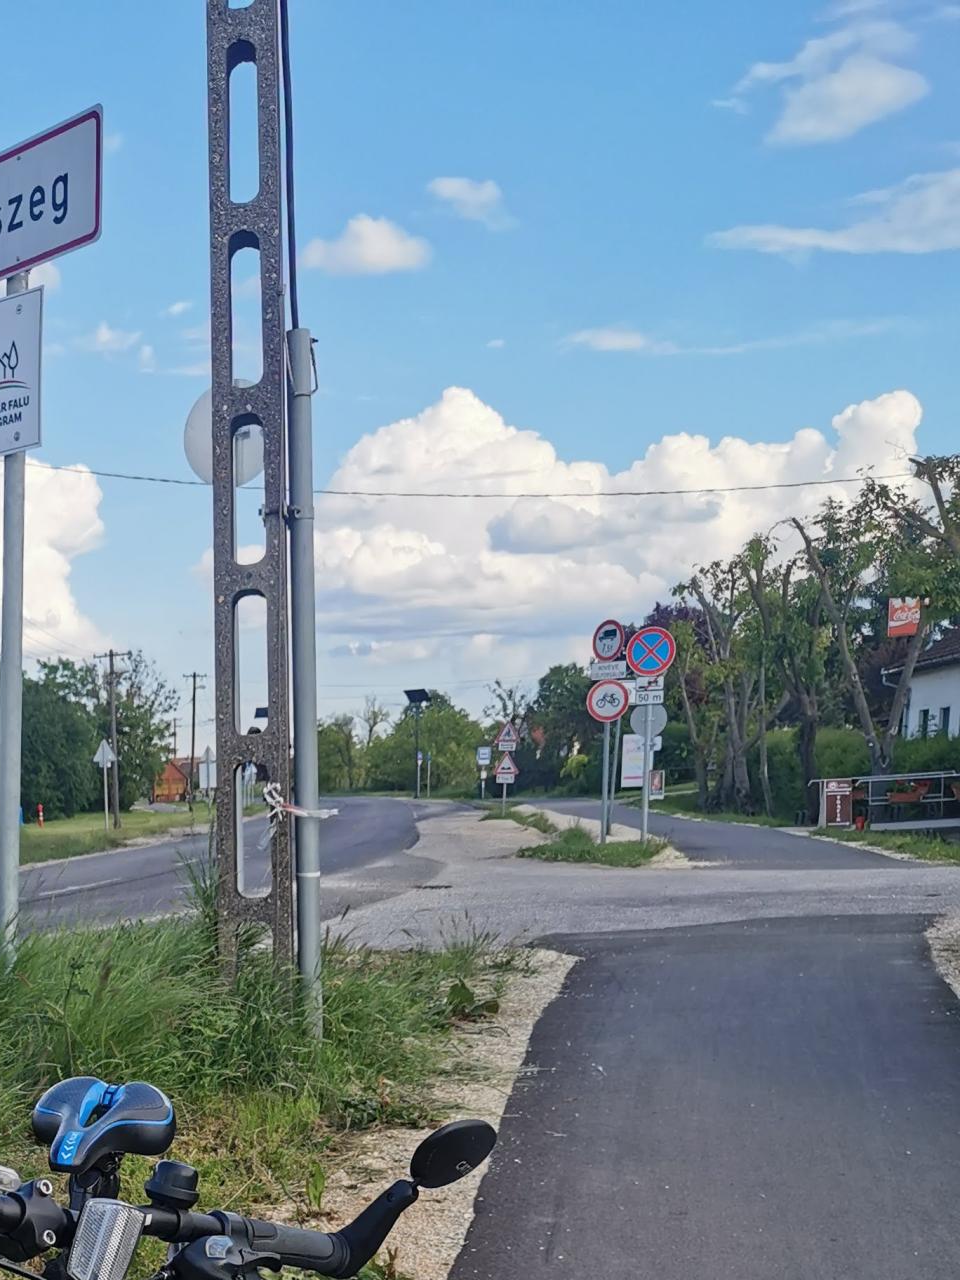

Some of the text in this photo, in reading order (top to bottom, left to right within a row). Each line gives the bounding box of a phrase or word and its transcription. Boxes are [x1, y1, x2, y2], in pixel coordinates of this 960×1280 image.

[8, 395, 30, 414] FALU
[638, 693, 662, 702] 50 m
